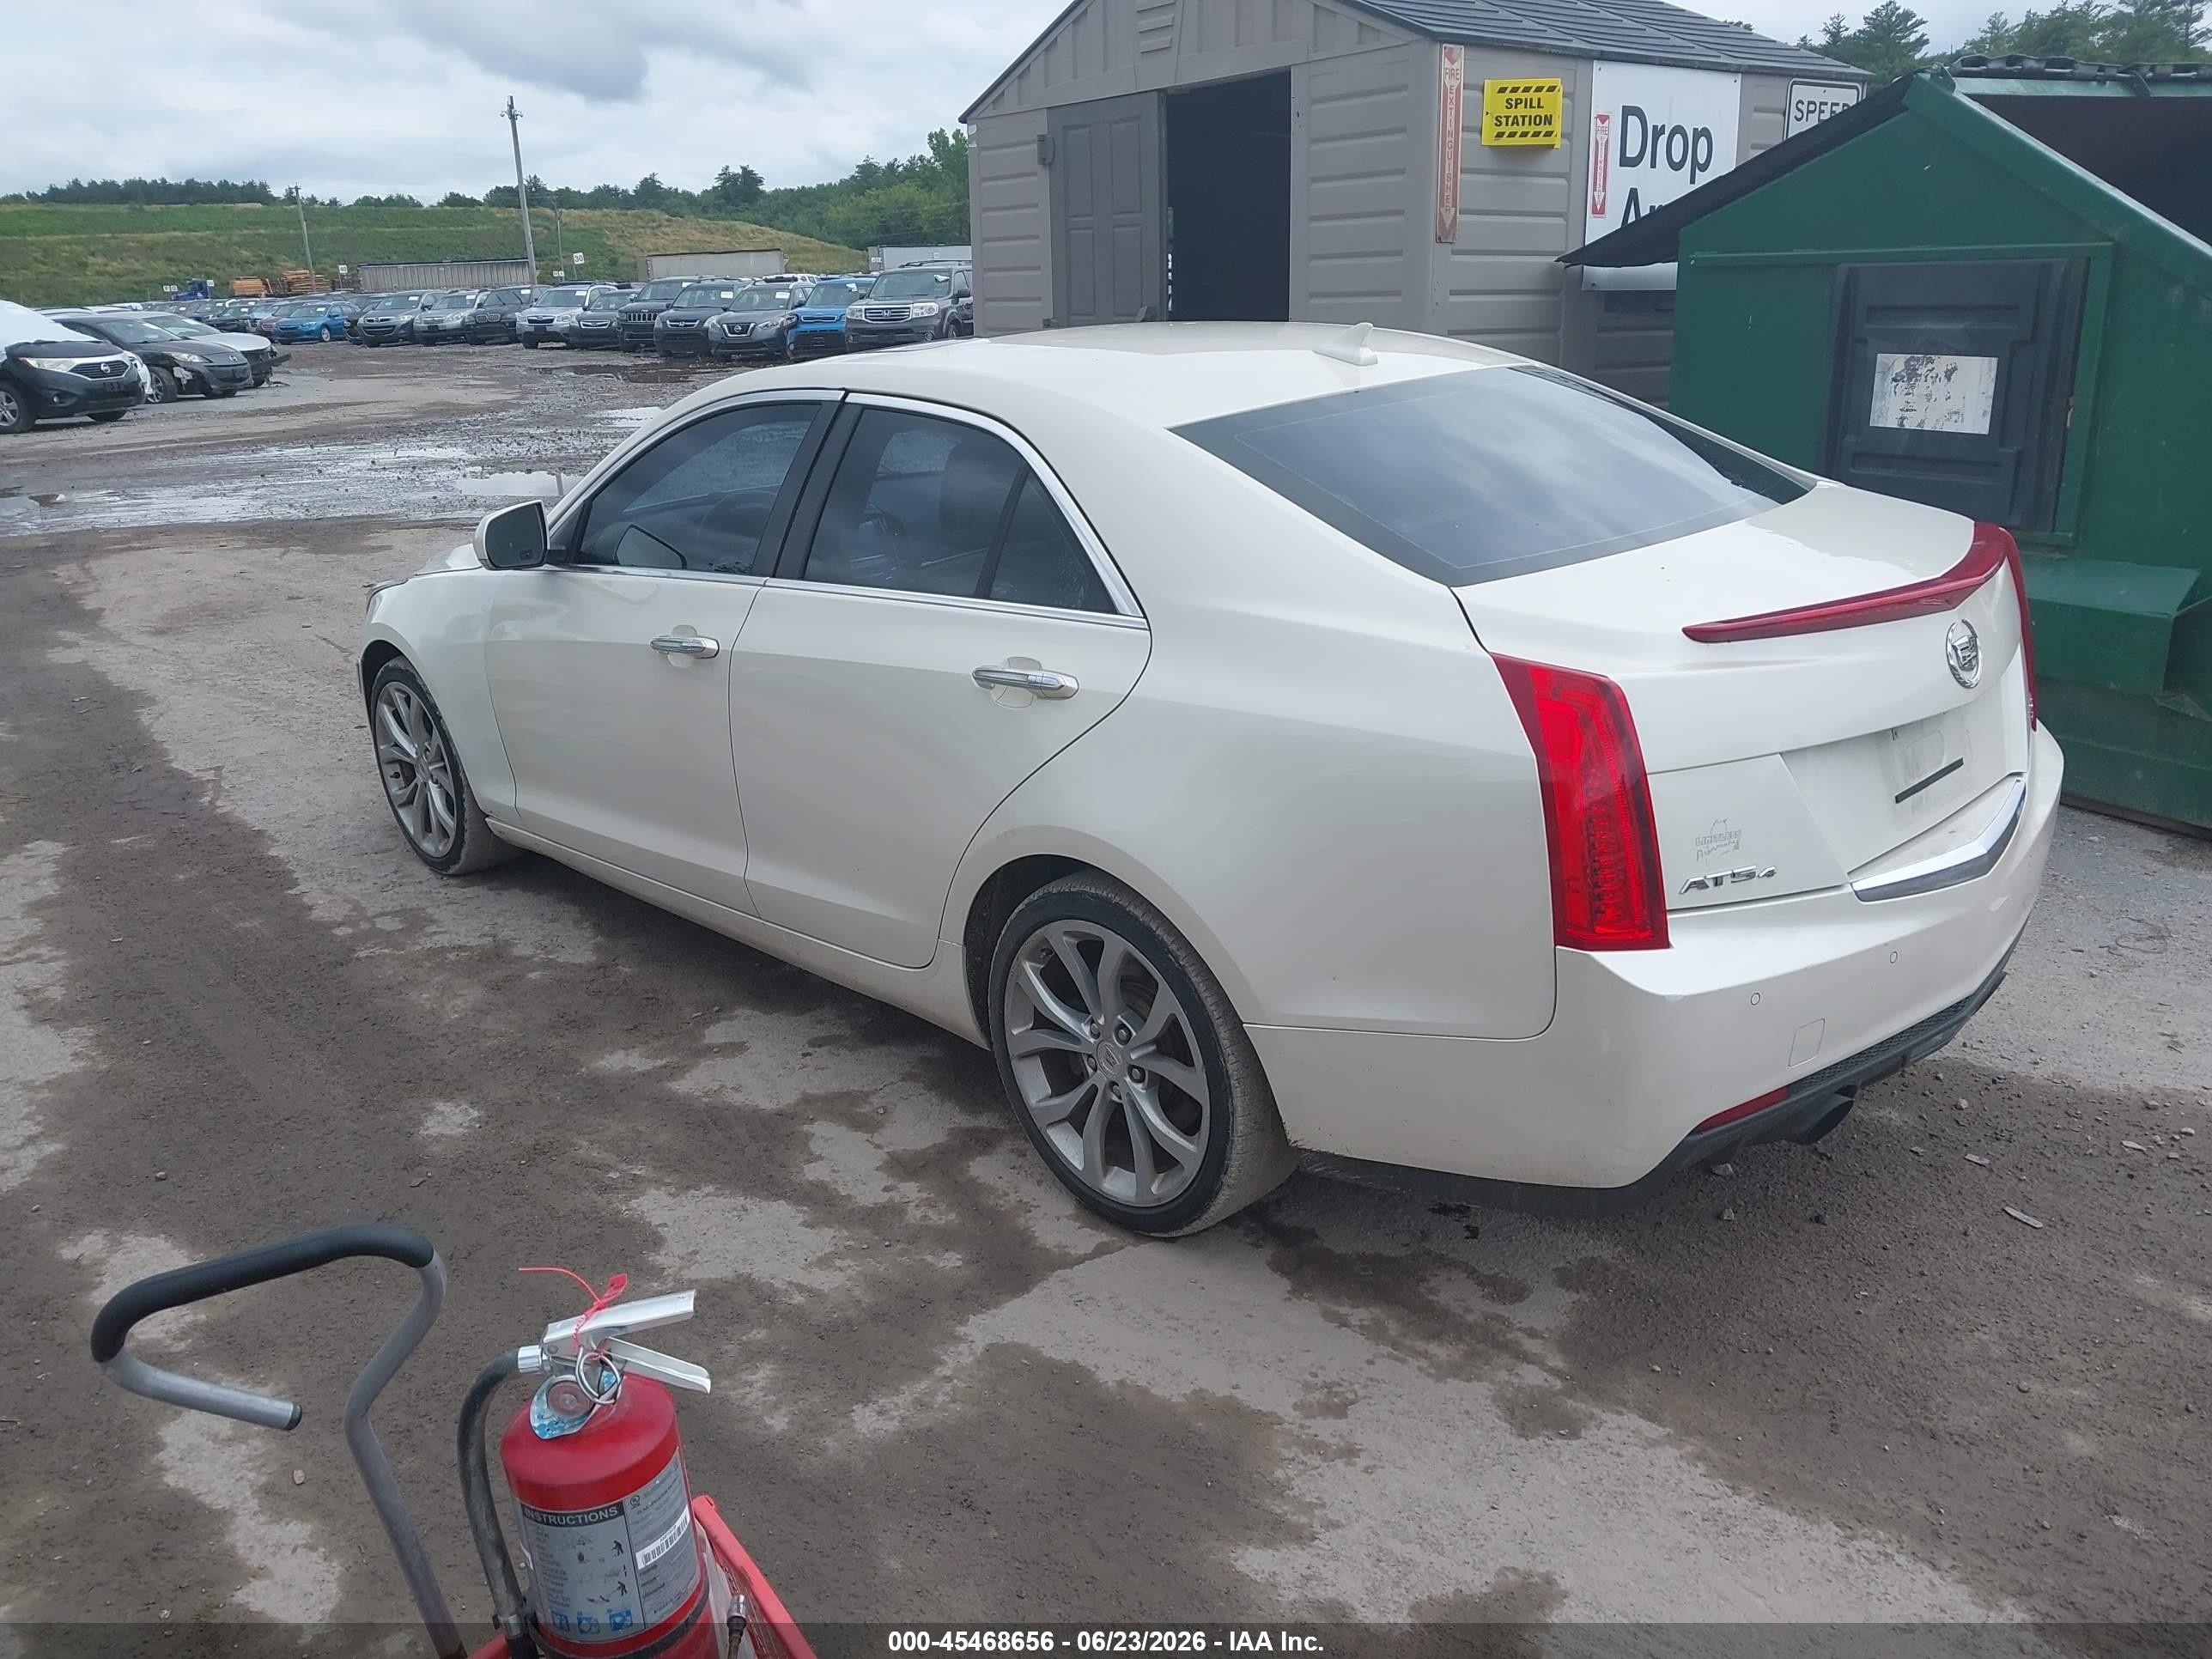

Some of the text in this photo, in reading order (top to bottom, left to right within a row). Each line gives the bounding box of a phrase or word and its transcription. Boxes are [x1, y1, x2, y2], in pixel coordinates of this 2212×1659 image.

[1444, 68, 1460, 81] FIRE
[1505, 97, 1544, 109] SPILL
[1494, 114, 1553, 127] STATION
[1597, 126, 1608, 136] FIRE
[1445, 85, 1455, 214] EXTINGUISHER
[1619, 105, 1713, 185] Drop
[574, 254, 584, 263] 30
[524, 1506, 619, 1526] INSTRUCTIONS
